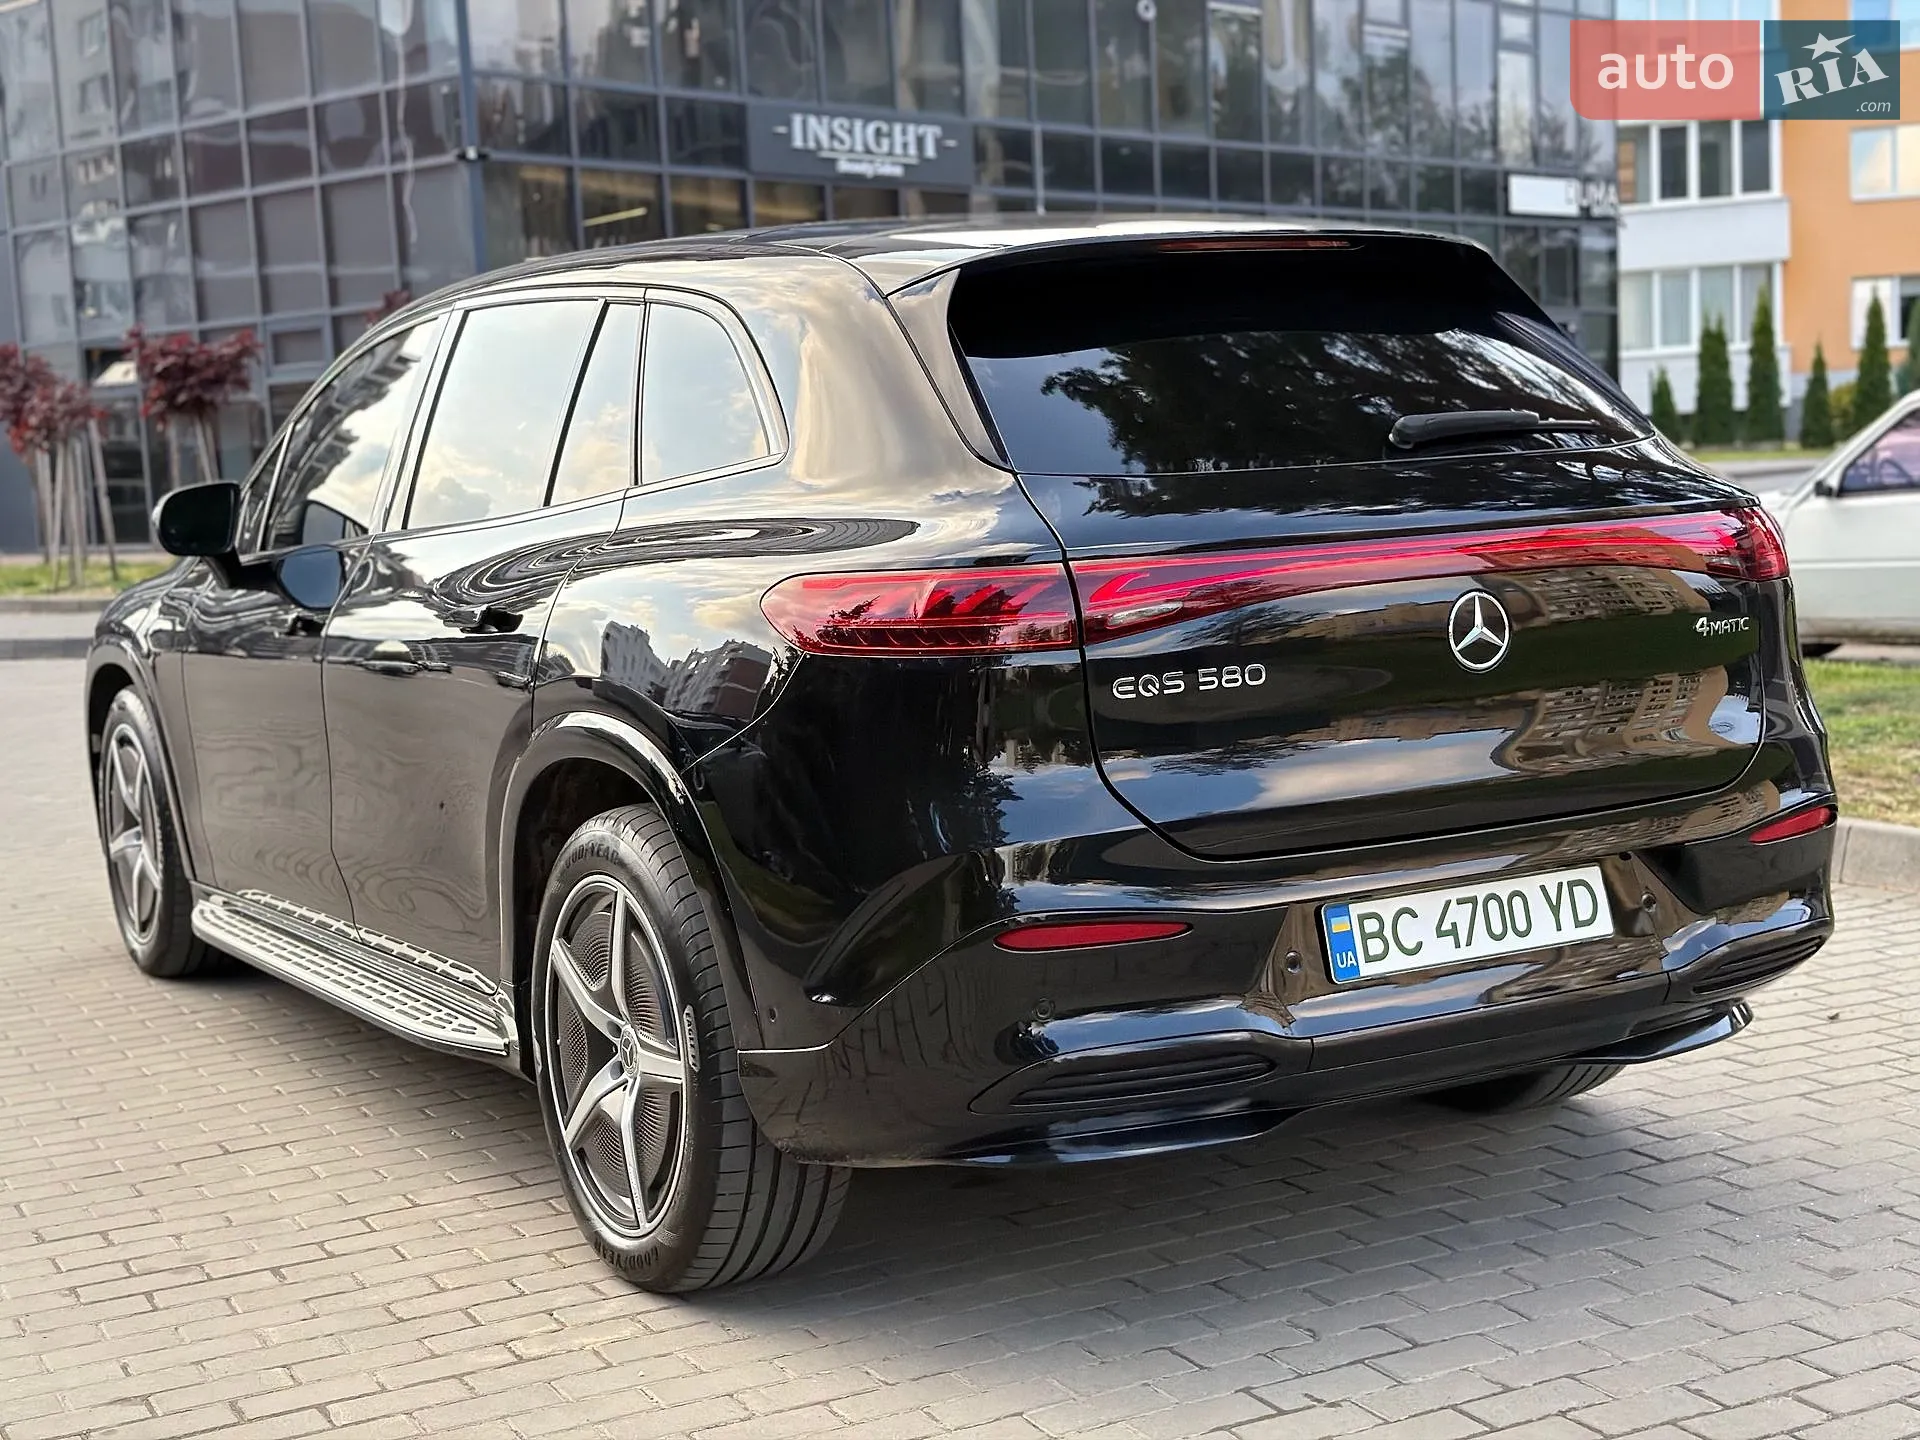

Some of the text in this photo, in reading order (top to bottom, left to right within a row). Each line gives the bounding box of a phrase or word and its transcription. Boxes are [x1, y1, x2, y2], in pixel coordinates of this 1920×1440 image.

[789, 112, 943, 160] INSIGHT
[1694, 616, 1750, 637] 4MATIC
[1112, 663, 1266, 700] EQS 580
[1357, 878, 1599, 964] BC 4700 YD
[1336, 951, 1357, 969] UA
